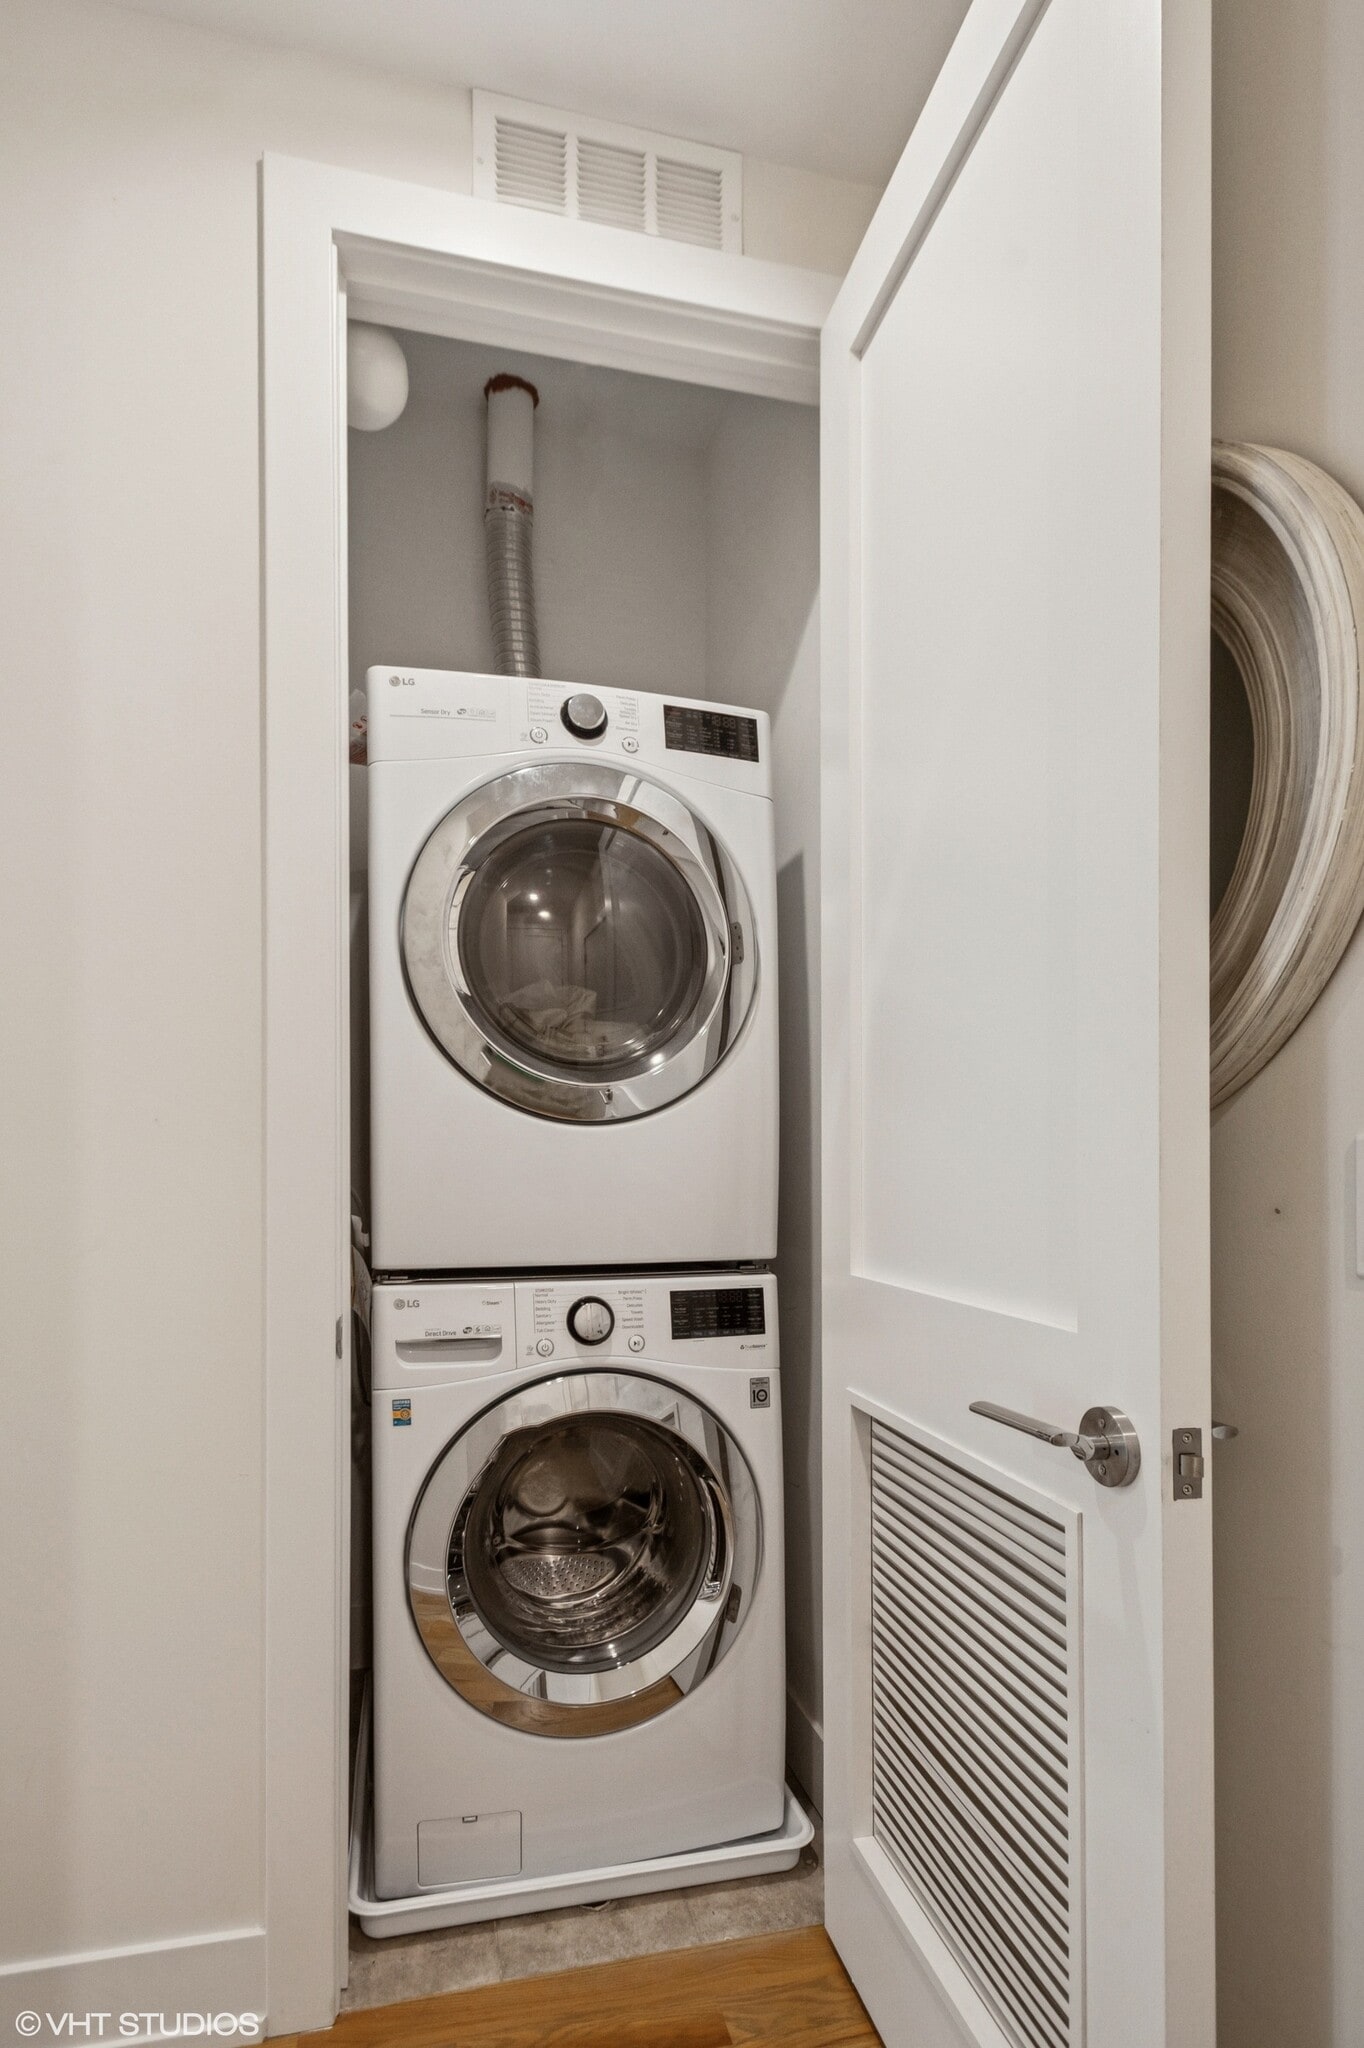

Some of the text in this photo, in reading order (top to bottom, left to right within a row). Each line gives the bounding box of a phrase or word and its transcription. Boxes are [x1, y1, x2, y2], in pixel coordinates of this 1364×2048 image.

[402, 678, 415, 686] LG
[407, 1299, 420, 1308] LG
[752, 1388, 768, 1402] 10
